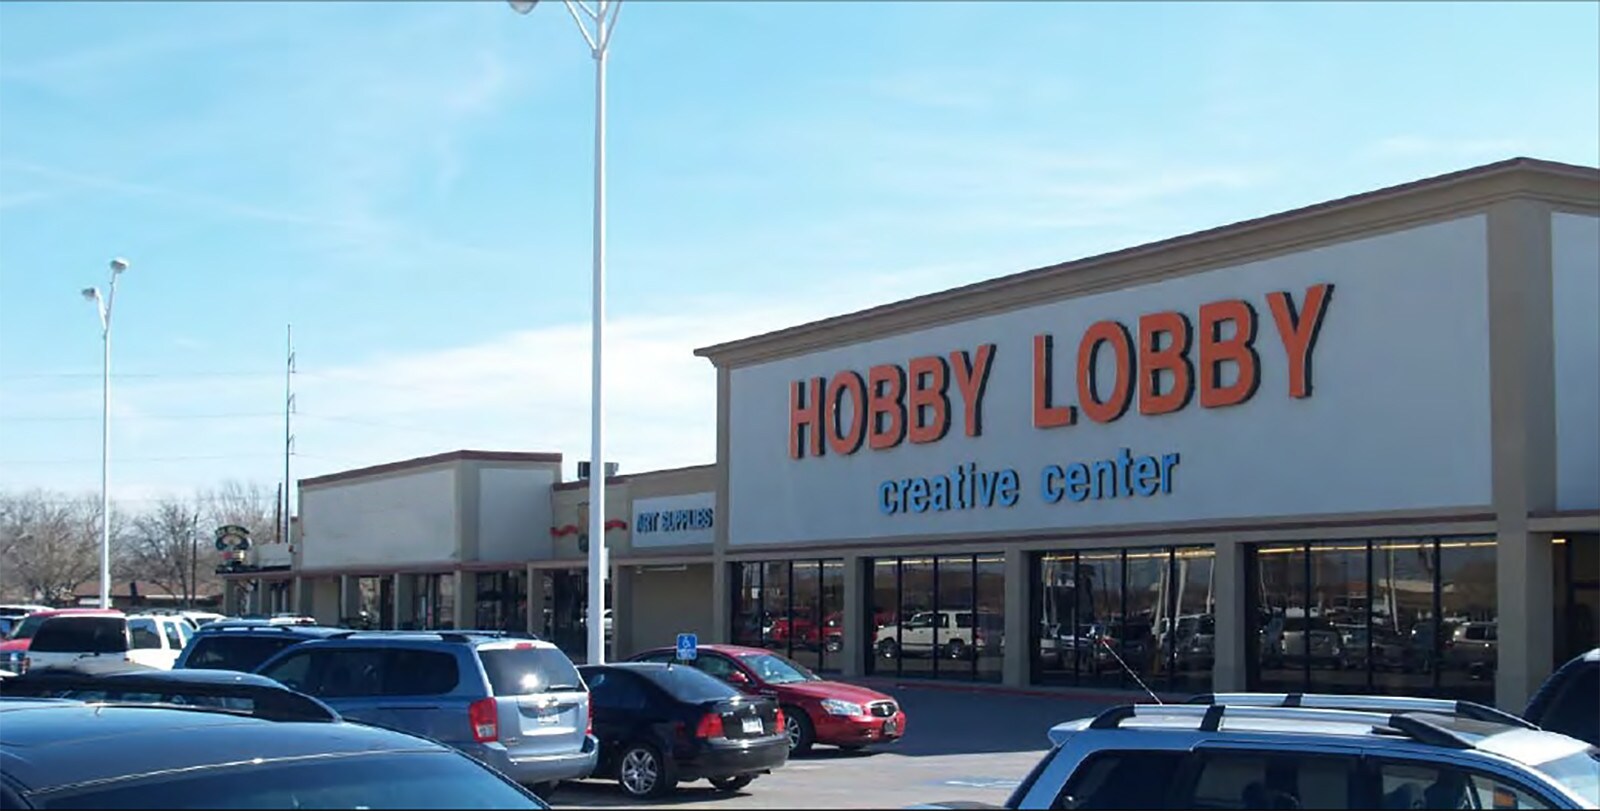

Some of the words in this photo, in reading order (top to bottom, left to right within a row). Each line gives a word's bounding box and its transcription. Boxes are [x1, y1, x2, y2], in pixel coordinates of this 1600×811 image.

[789, 344, 997, 459] HOBBY
[1034, 284, 1334, 428] LOBBY
[878, 462, 1019, 515] creative
[1040, 448, 1180, 503] center
[636, 511, 660, 532] ART
[661, 508, 714, 532] SUPPLIES
